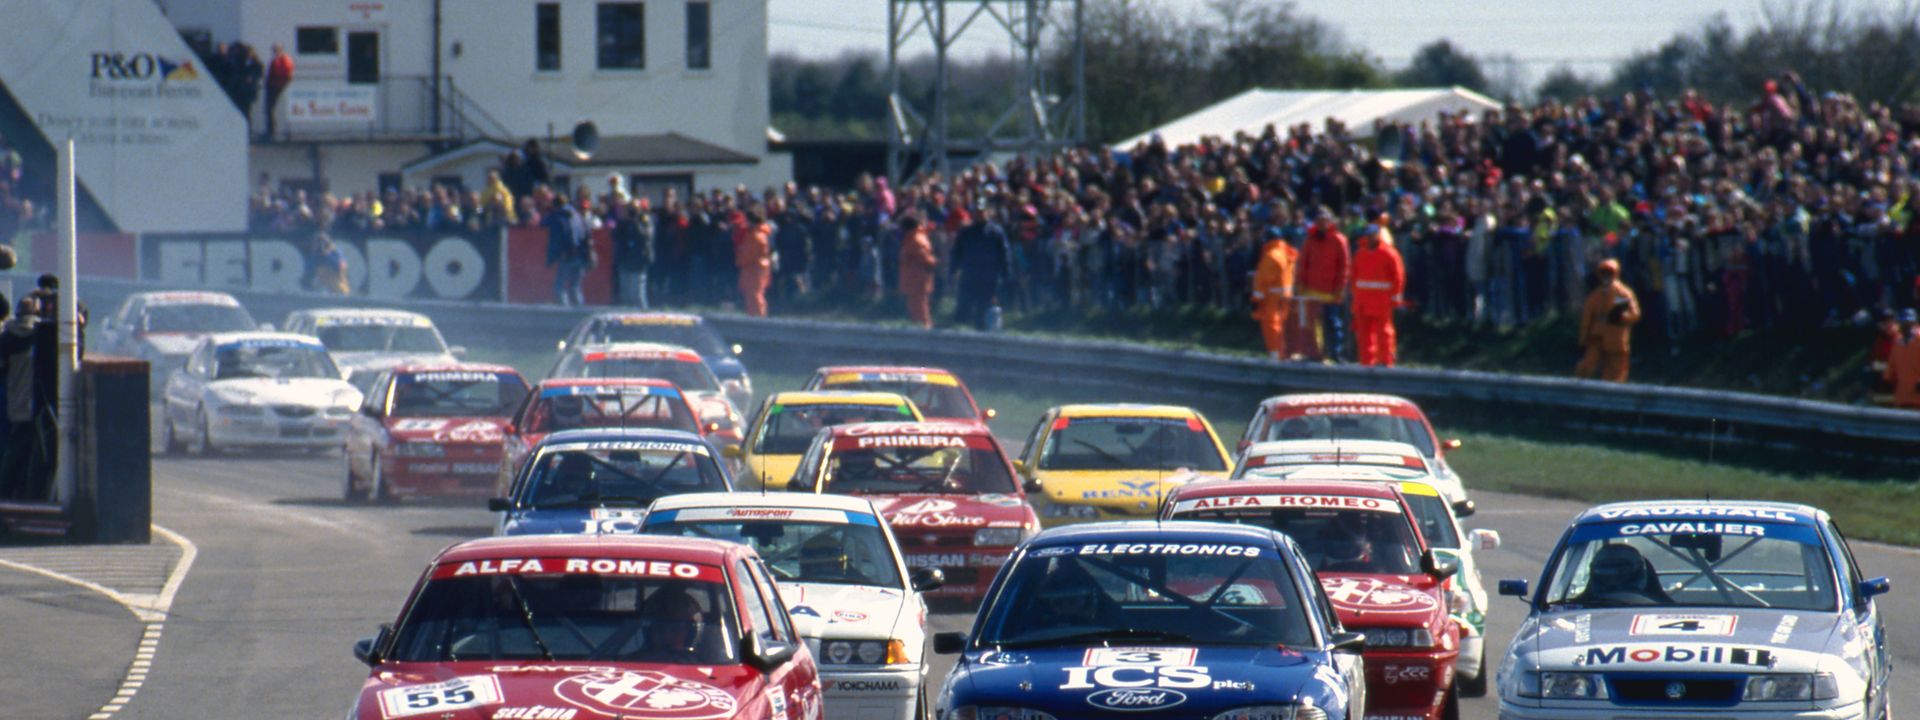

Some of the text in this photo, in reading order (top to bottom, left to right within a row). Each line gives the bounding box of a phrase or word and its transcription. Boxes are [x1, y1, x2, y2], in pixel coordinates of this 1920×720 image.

[91, 53, 155, 79] P&O
[415, 372, 499, 382] PRIMERA
[1305, 406, 1391, 414] CAVALIER
[588, 442, 702, 453] ELECTRONICS
[858, 435, 967, 448] PRIMERA
[1194, 496, 1380, 509] ALFA ROMEO
[1598, 507, 1796, 522] VAUXHALL
[1620, 523, 1765, 536] CAVALIER
[1079, 544, 1261, 557] ELECTRONICS
[455, 559, 700, 578] ALFA ROMEO
[1658, 621, 1705, 631] 4
[1116, 653, 1162, 663] 3
[1586, 647, 1724, 665] Mobil
[1059, 666, 1212, 690] ICS
[837, 681, 900, 691] YOKOHAMA
[407, 685, 475, 708] 55
[1105, 690, 1165, 706] Ford
